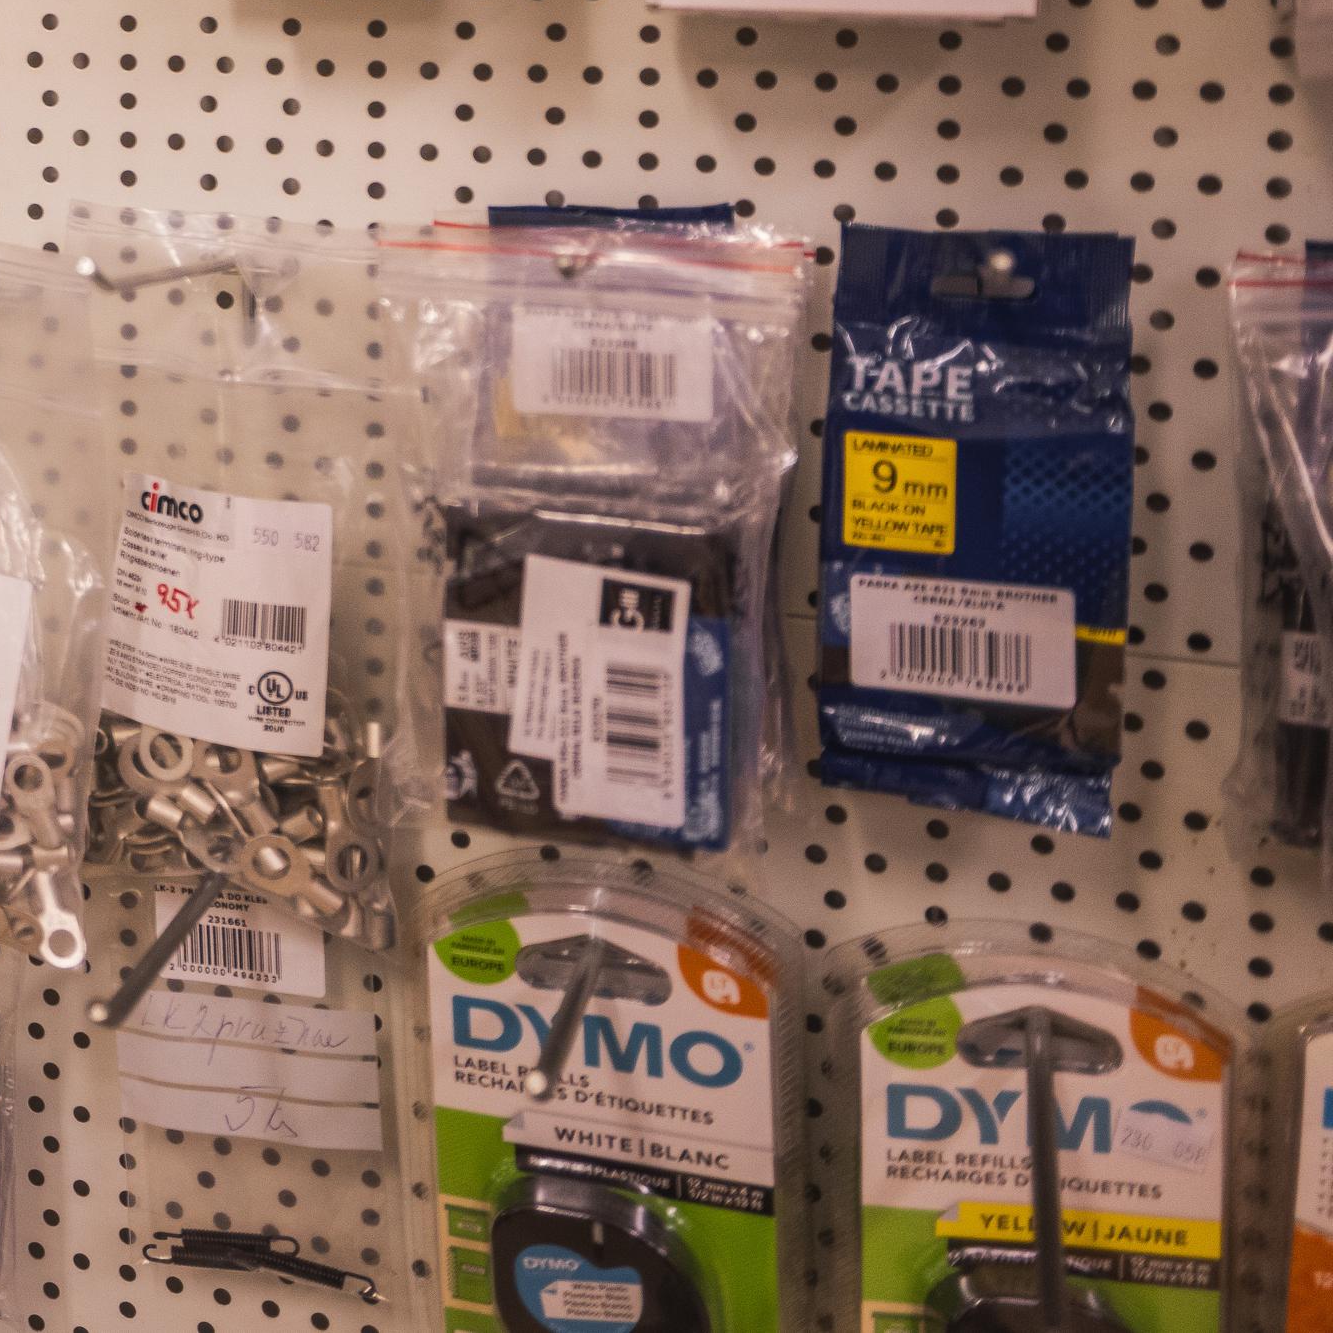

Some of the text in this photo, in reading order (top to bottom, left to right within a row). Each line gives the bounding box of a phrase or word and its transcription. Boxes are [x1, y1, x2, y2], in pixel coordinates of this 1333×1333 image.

[844, 356, 976, 403] TAPE
[842, 392, 976, 423] CASSETTE
[851, 438, 934, 458] LAMINATED
[870, 460, 949, 499] 9 mm
[140, 482, 204, 525] cimco
[851, 498, 926, 517] BLACK ON
[851, 515, 949, 537] YELLOW TAPE
[207, 915, 247, 928] 231661
[451, 956, 505, 972] EUROPE
[888, 1042, 947, 1056] EUROPE
[453, 1054, 512, 1074] LABEL
[574, 1090, 714, 1126] D'ÉTIQUETTES
[554, 1126, 731, 1171] WHITE BLANC
[886, 1149, 949, 1166] LABEL
[886, 1166, 1007, 1187] RECHARGES
[1103, 1222, 1189, 1246] JAUNE
[522, 1257, 580, 1272] DYMO
